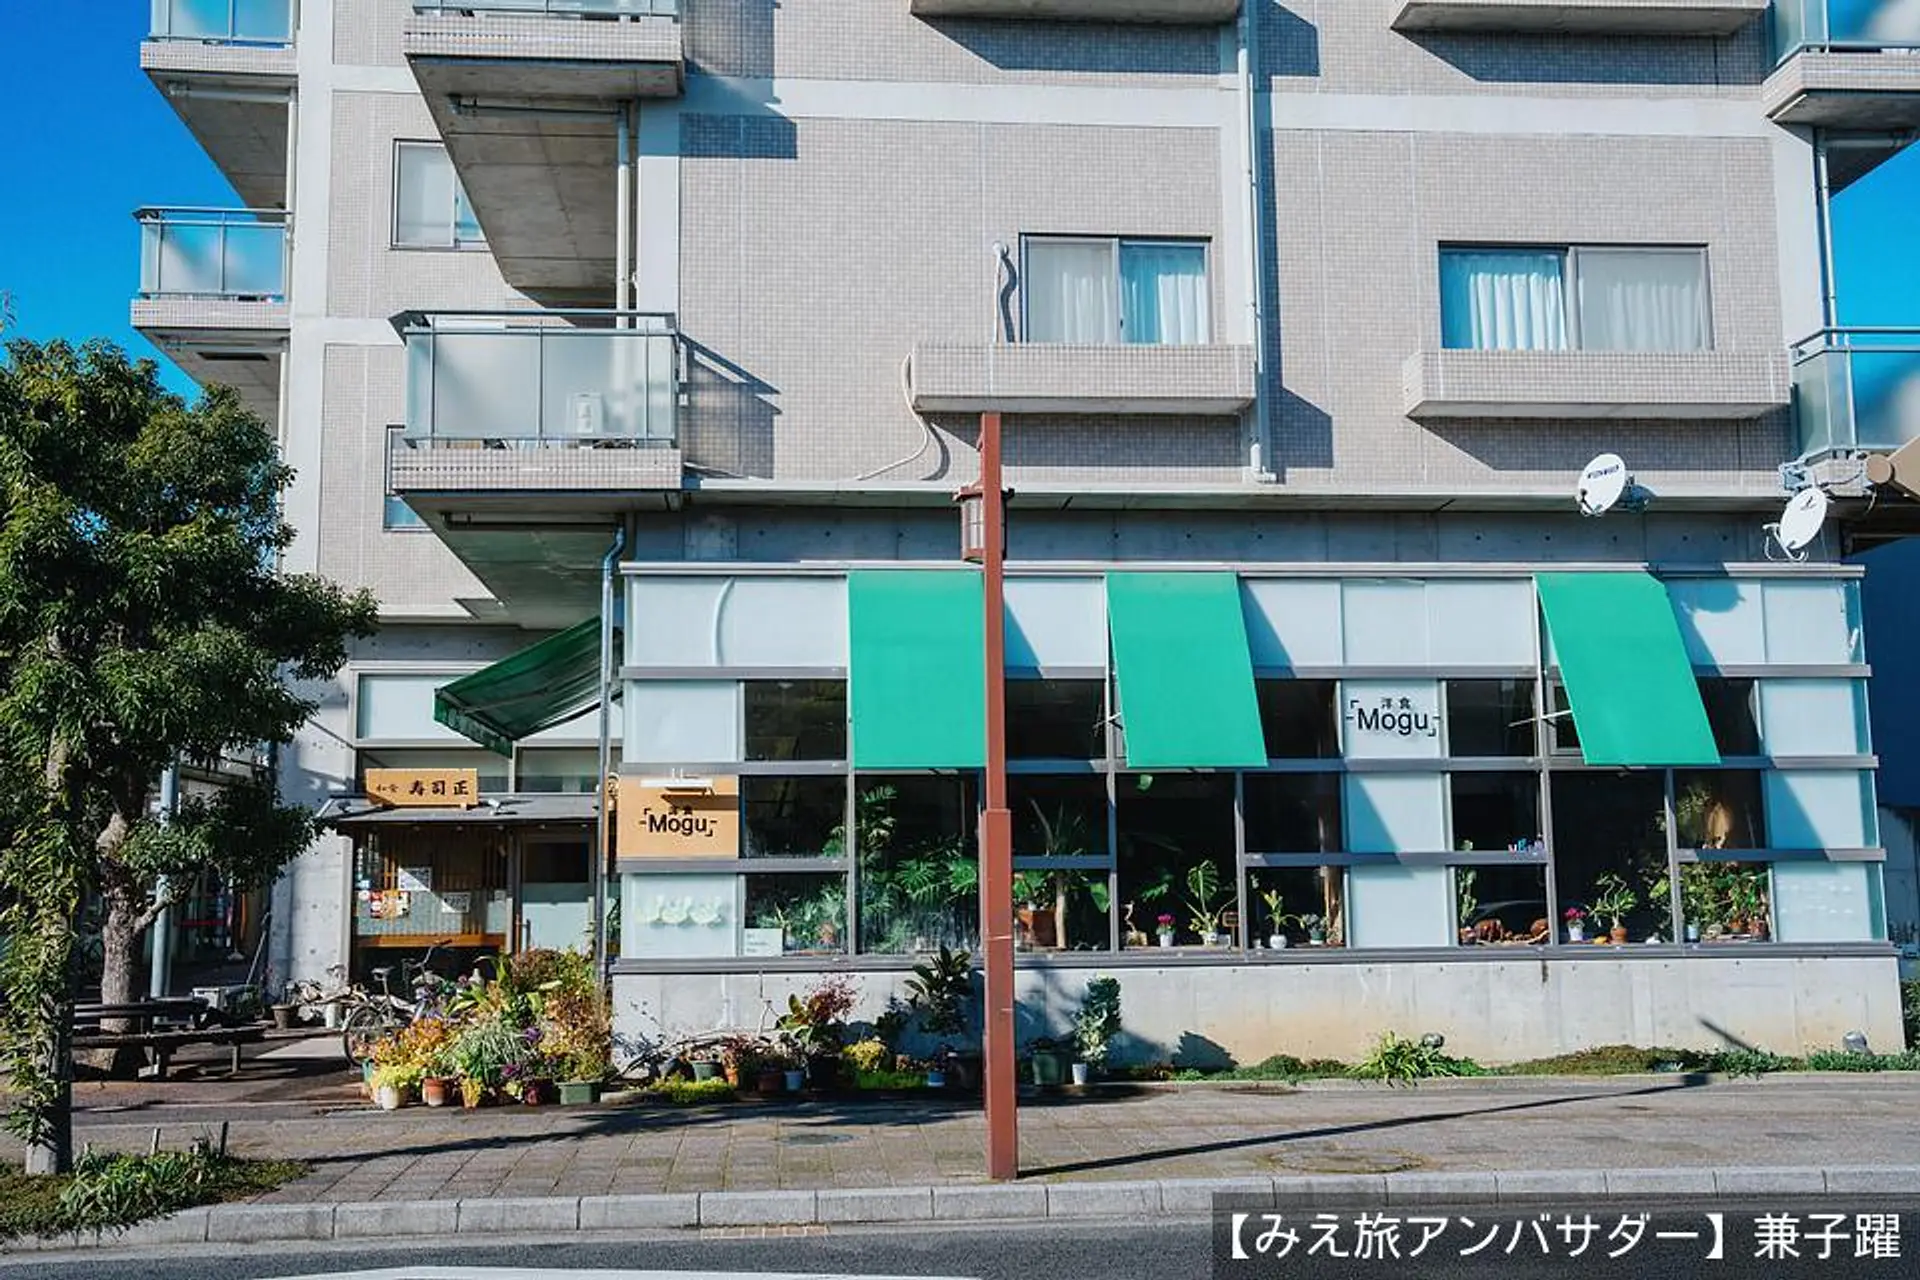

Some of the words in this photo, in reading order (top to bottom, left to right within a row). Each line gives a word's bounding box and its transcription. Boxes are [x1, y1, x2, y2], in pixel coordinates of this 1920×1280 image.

[1381, 697, 1412, 709] 洋食
[408, 780, 469, 797] 寿司正
